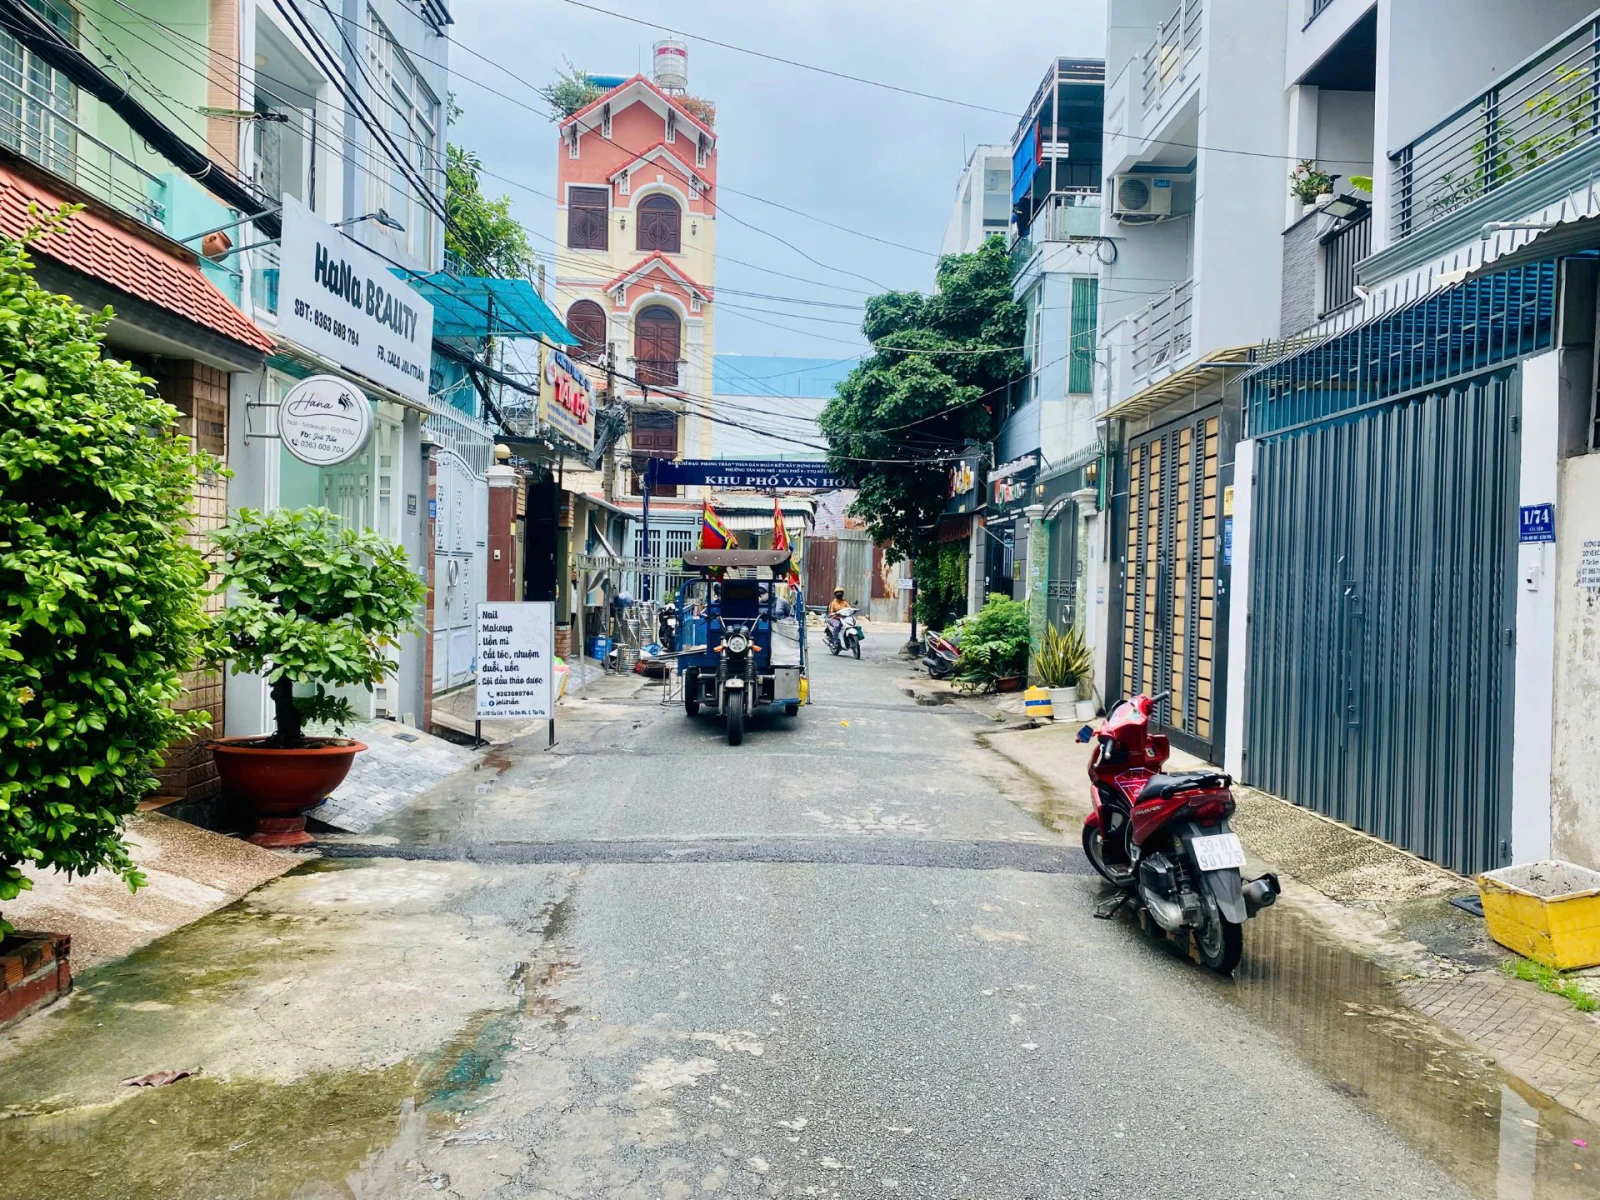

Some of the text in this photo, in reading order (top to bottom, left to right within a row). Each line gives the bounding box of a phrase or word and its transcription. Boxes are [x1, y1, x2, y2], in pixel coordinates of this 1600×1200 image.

[315, 241, 418, 343] HaNa BEAUTY
[294, 298, 313, 323] SĐT:
[314, 309, 332, 333] 0363
[387, 350, 401, 370] ZALO
[289, 391, 334, 412] Hana
[300, 440, 344, 453] 0363 608 704
[704, 475, 741, 485] KHU
[745, 473, 779, 486] PHỐ
[782, 475, 818, 487] VĂN
[1523, 508, 1550, 525] 1/74
[482, 610, 498, 619] Nail
[482, 623, 513, 634] Makeup
[499, 637, 509, 646] mi
[513, 649, 540, 660] nhuộm
[504, 660, 519, 672] uốn
